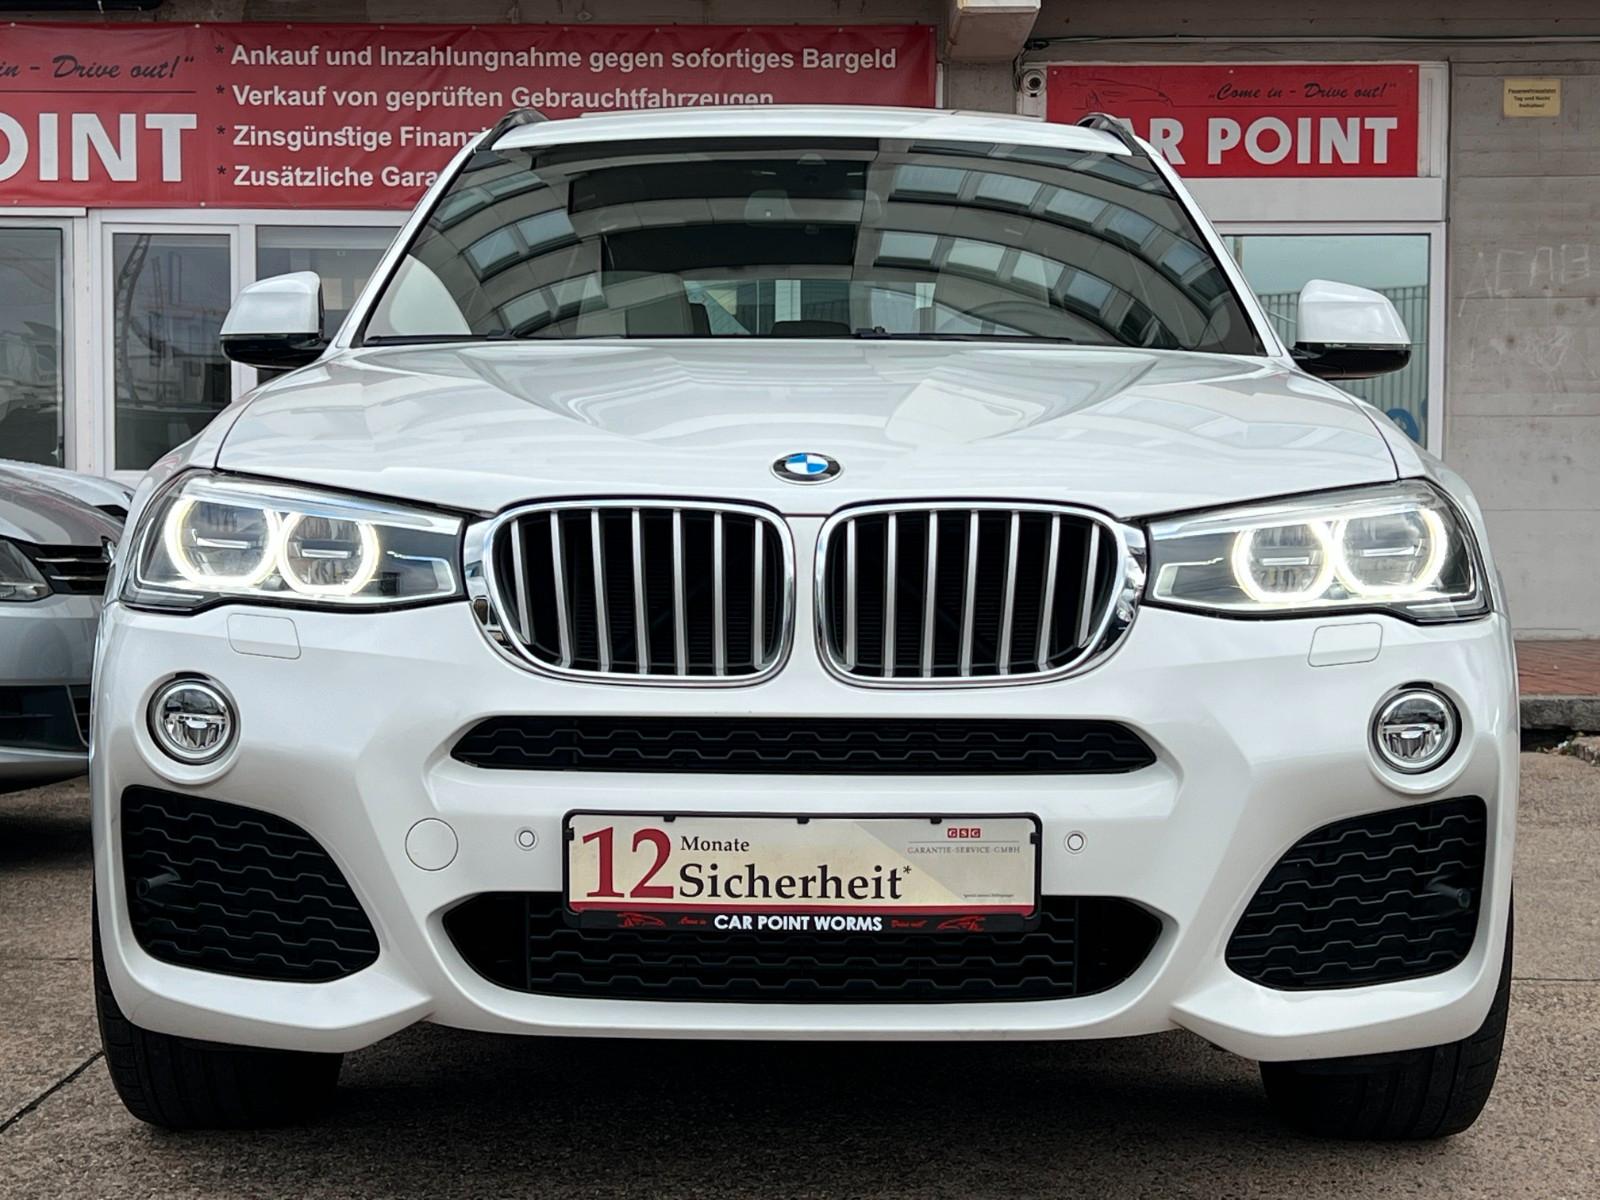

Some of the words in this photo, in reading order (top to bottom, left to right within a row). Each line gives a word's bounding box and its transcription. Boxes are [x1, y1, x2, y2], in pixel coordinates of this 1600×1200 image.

[52, 55, 121, 78] Drive
[231, 45, 319, 66] Ankauf
[324, 46, 373, 67] und
[380, 47, 582, 72] Inzahlungnahme
[589, 53, 664, 72] gegen
[671, 48, 795, 73] sofortiges
[802, 49, 897, 73] Bargeld
[232, 86, 326, 107] Verkauf
[332, 91, 378, 107] von
[385, 87, 503, 111] geprüften
[1267, 87, 1283, 98] in
[1304, 82, 1348, 99] Drive
[233, 126, 392, 152] Zinsgünstige
[400, 126, 488, 147] Finan
[1208, 117, 1397, 165] POINT
[233, 165, 373, 187] Zusätzliche
[681, 836, 750, 852] Monate
[947, 828, 981, 838] GSG
[582, 826, 674, 899] 12
[714, 914, 753, 930] CAR
[758, 915, 809, 931] POINT
[815, 915, 883, 932] WORMS
